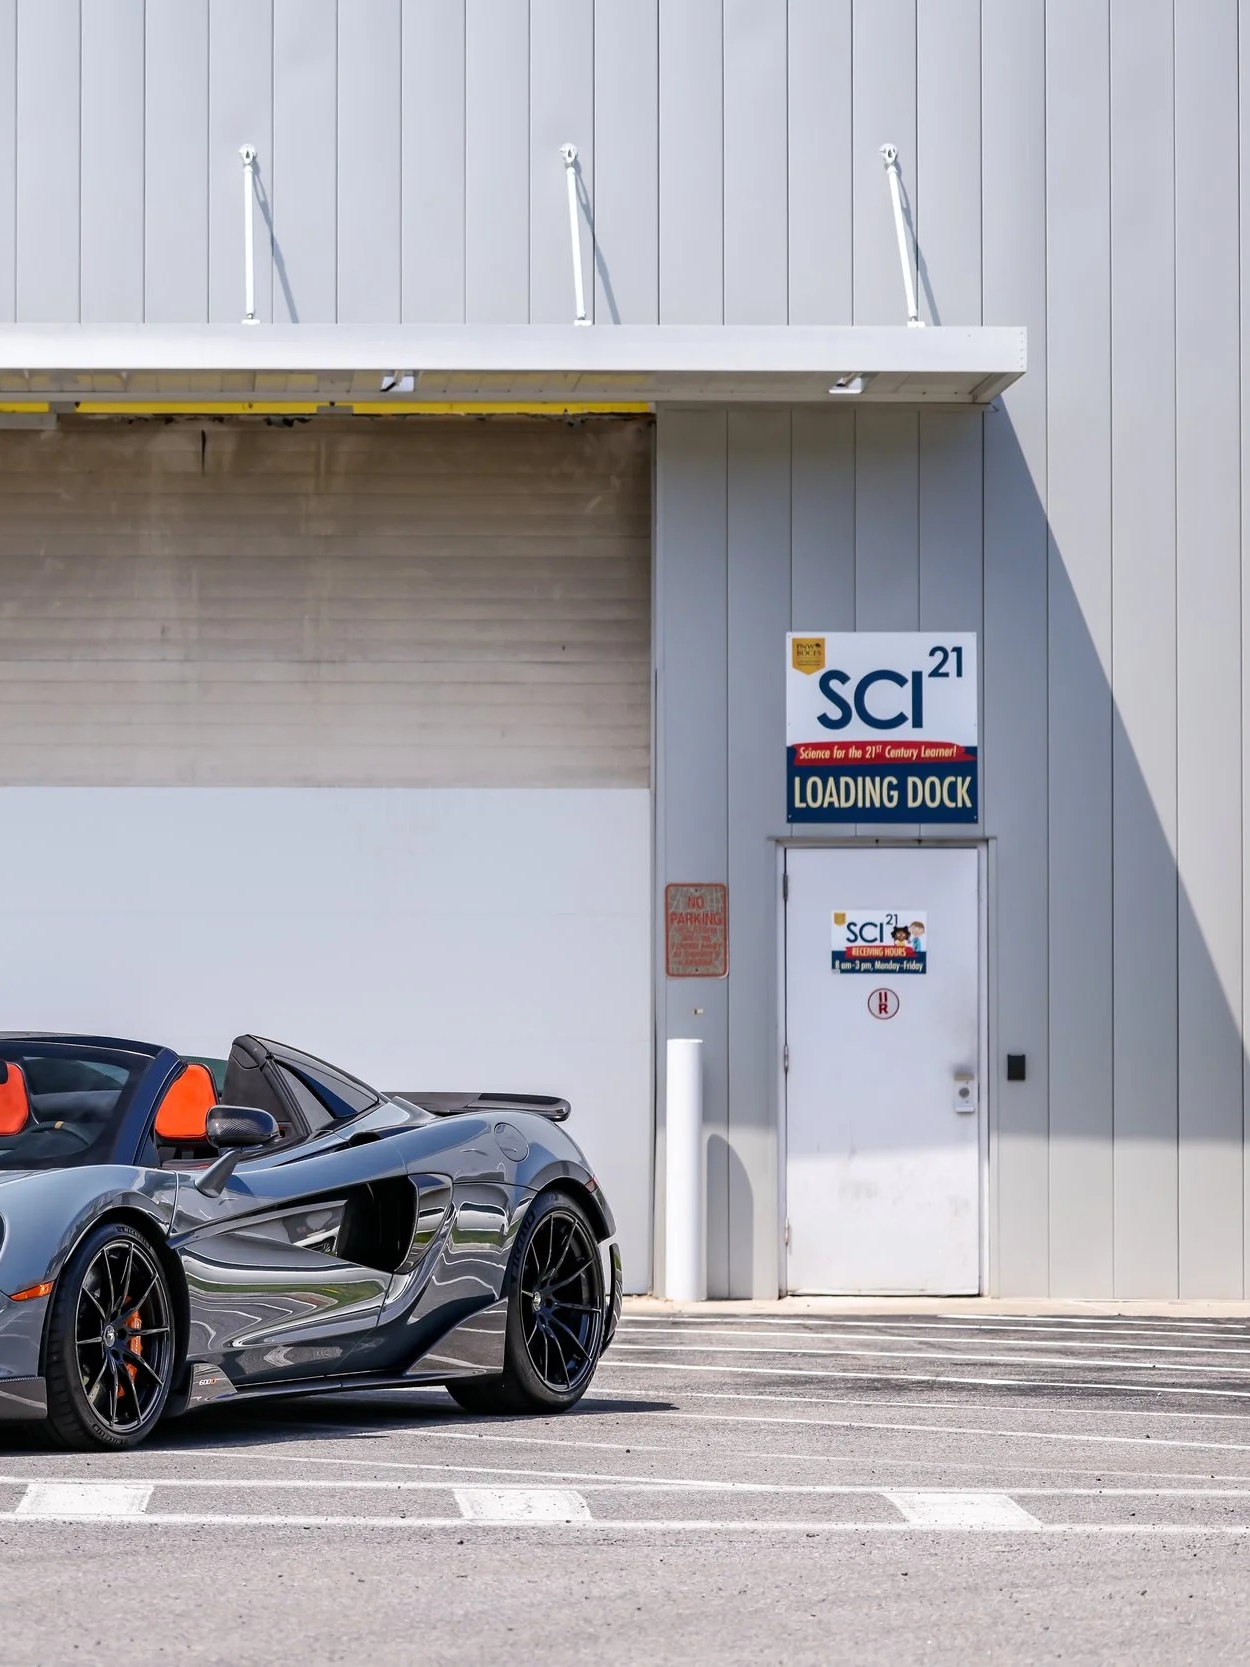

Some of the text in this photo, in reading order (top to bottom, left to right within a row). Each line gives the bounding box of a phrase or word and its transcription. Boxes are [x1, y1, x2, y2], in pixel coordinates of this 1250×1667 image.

[799, 745, 830, 760] Science
[833, 744, 845, 760] for
[849, 745, 862, 759] the
[885, 745, 918, 760] Century
[921, 745, 957, 758] Learner!
[794, 776, 972, 808] LOADING DOCK
[687, 895, 705, 909] NO
[670, 912, 722, 925] PARKING
[852, 947, 907, 957] RECEIVING HOURS
[835, 960, 840, 969] 8
[861, 962, 873, 971] pm,
[878, 1003, 888, 1014] R
